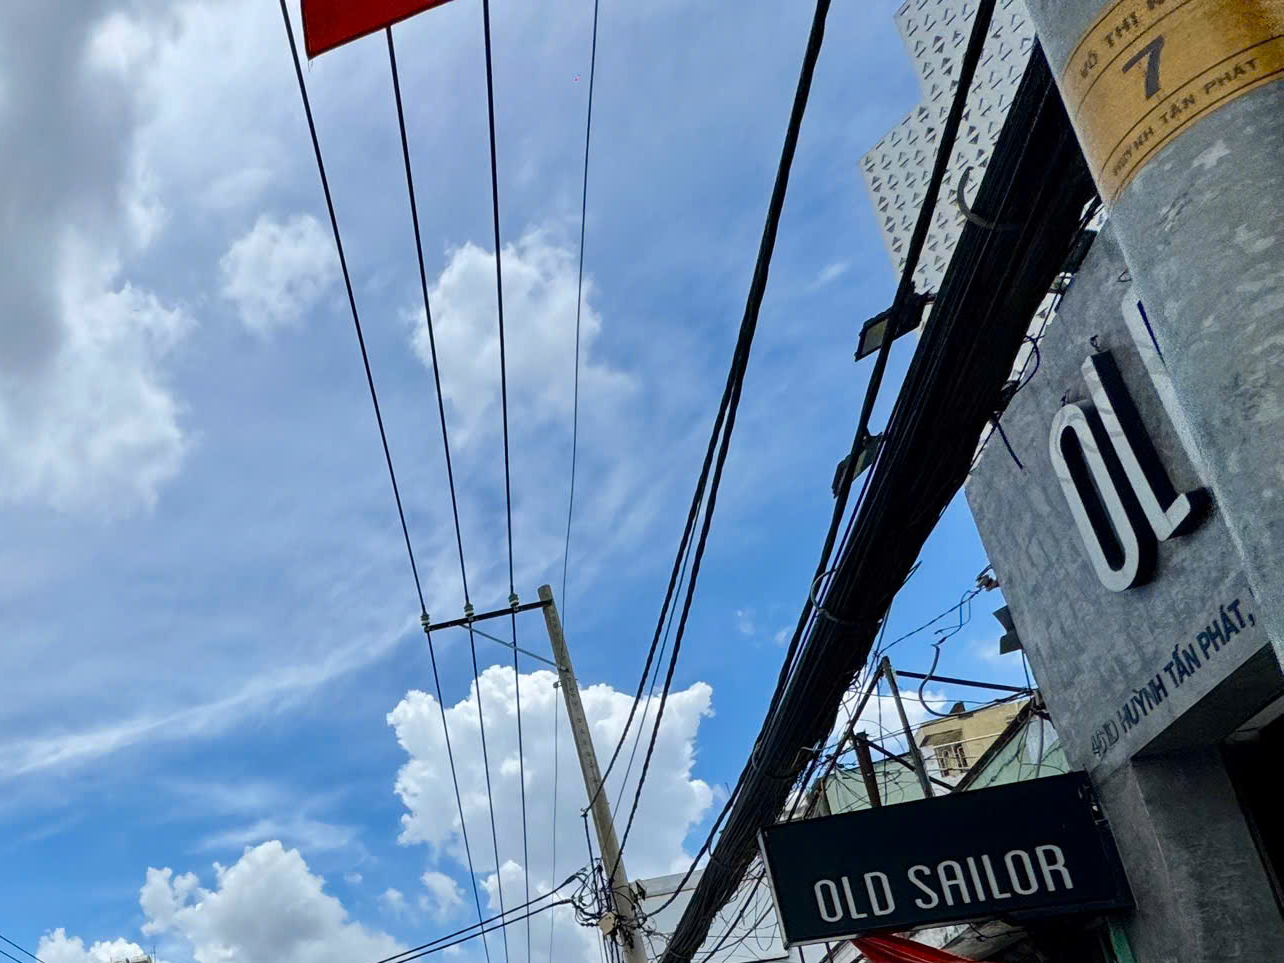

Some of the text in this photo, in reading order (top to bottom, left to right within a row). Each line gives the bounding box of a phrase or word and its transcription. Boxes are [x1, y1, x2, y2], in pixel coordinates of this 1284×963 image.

[1121, 34, 1165, 100] 7
[1117, 673, 1168, 733] HUỲNH
[814, 844, 1074, 923] OLD SAILOR
